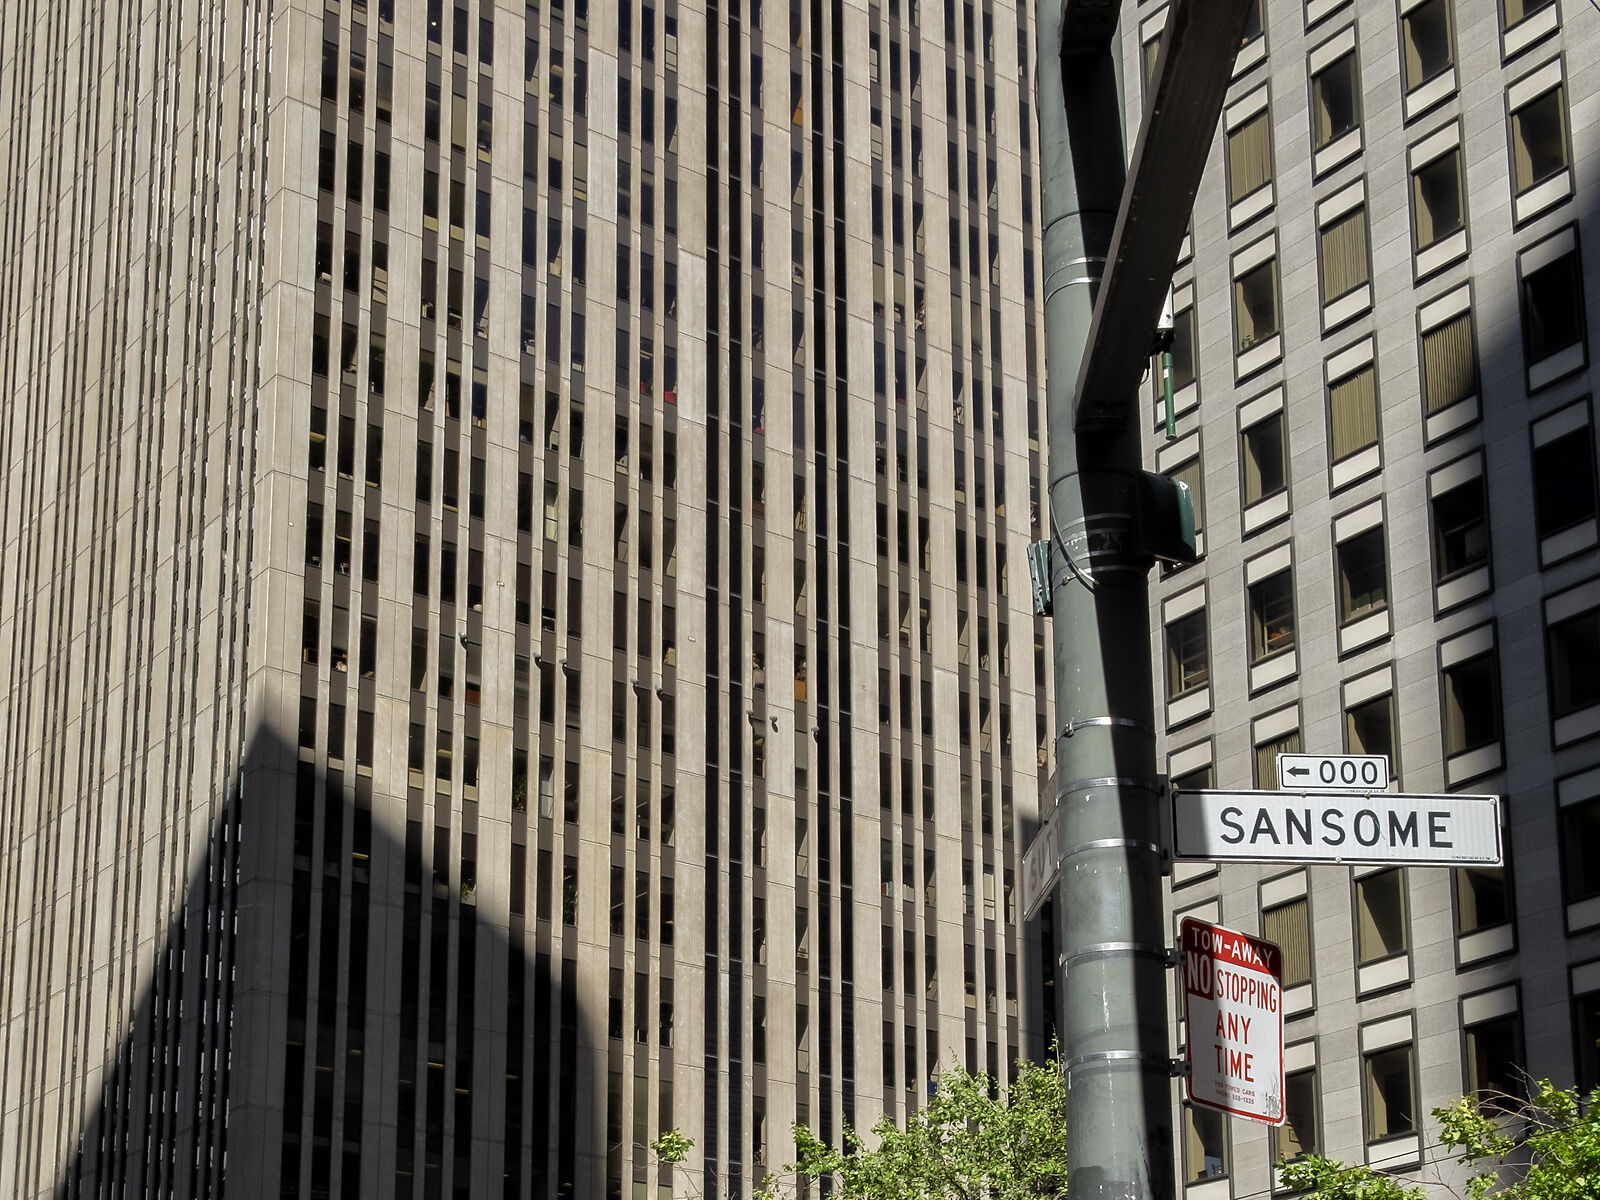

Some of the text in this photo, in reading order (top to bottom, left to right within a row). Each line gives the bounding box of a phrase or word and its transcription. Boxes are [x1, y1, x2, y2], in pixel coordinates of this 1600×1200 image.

[1319, 760, 1378, 785] 000
[1220, 807, 1453, 849] SANSOME
[1191, 927, 1273, 969] TOW-AWAY
[1187, 950, 1277, 1013] NO STOPPING
[1216, 1009, 1252, 1045] ANY
[1214, 1044, 1254, 1083] TIME
[1242, 1088, 1255, 1097] CARS
